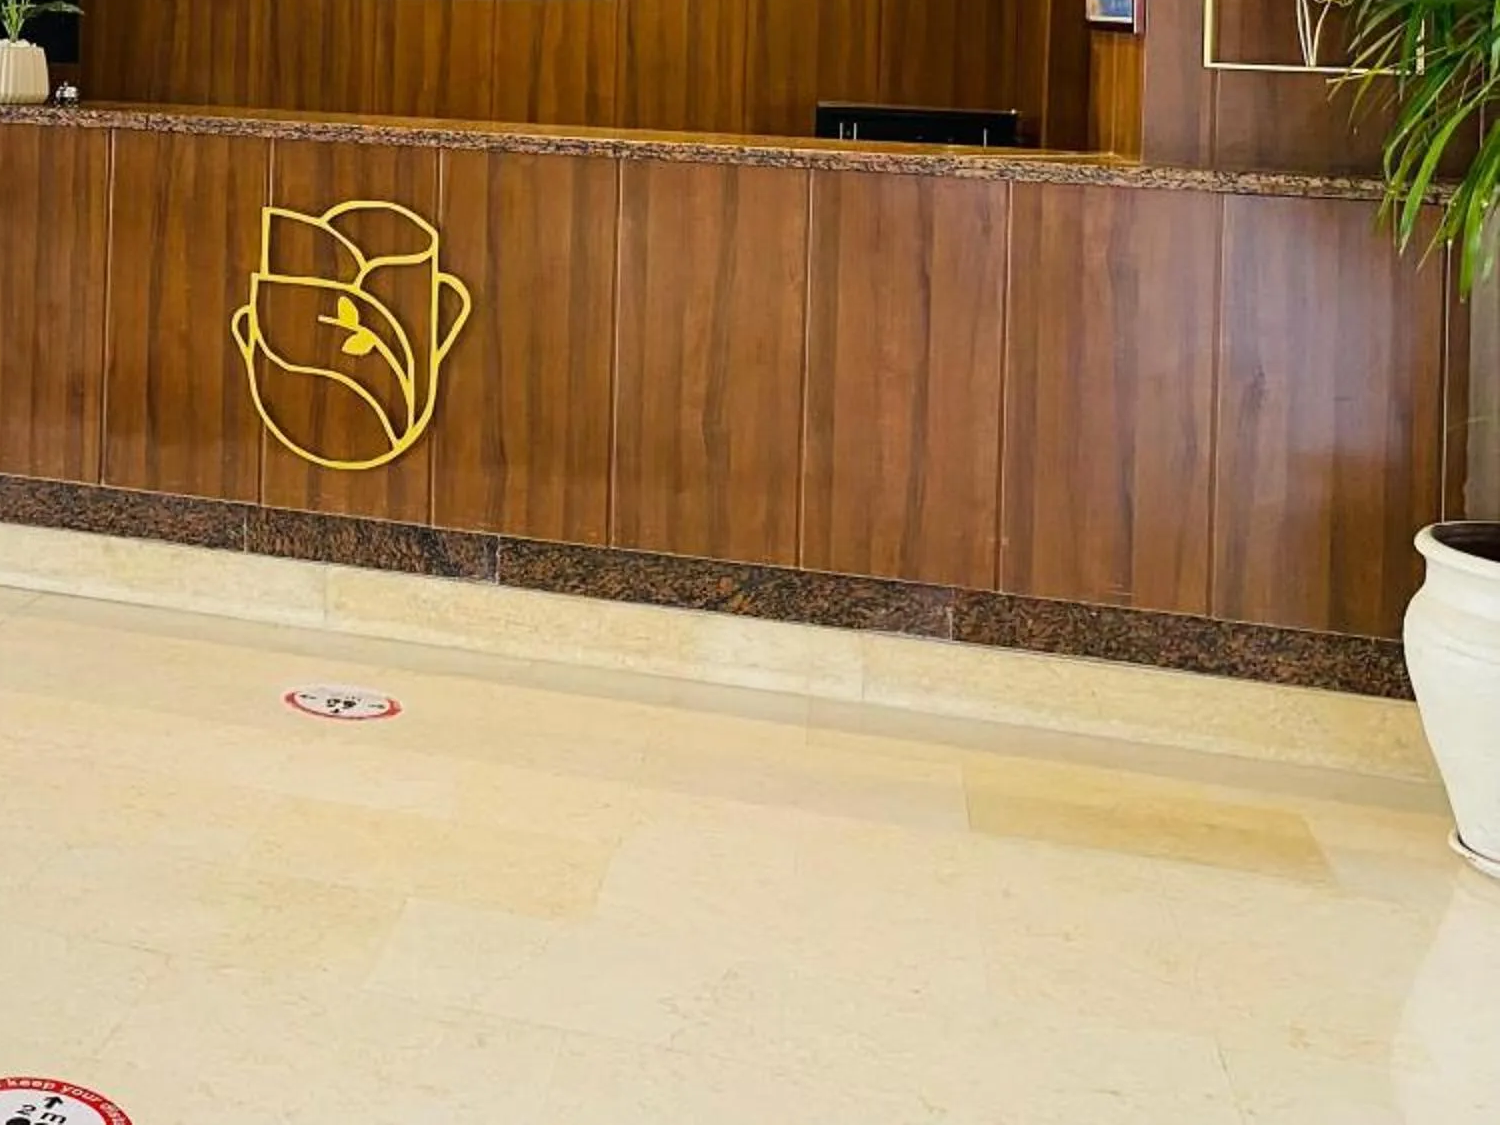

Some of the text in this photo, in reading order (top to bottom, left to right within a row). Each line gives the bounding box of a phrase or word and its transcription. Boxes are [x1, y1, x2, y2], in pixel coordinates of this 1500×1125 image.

[6, 1078, 56, 1090] keep
[61, 1083, 102, 1103] your
[16, 1104, 67, 1124] 2 m
